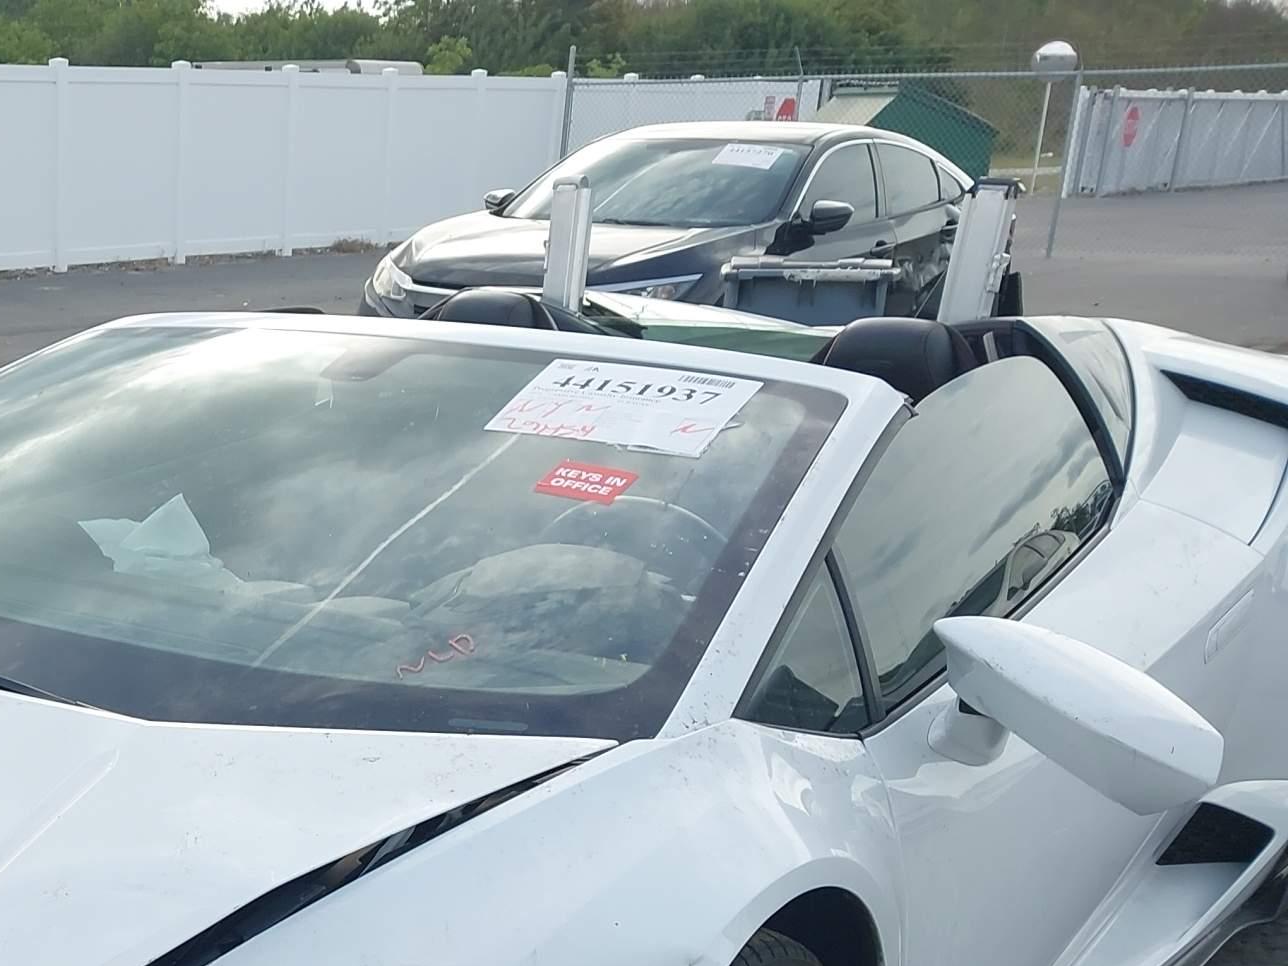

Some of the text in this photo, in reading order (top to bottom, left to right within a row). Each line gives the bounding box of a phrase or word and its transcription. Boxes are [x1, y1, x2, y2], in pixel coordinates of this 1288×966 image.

[553, 374, 723, 406] 44151937
[549, 477, 614, 497] OFFICE
[554, 466, 628, 488] KEYS IN
